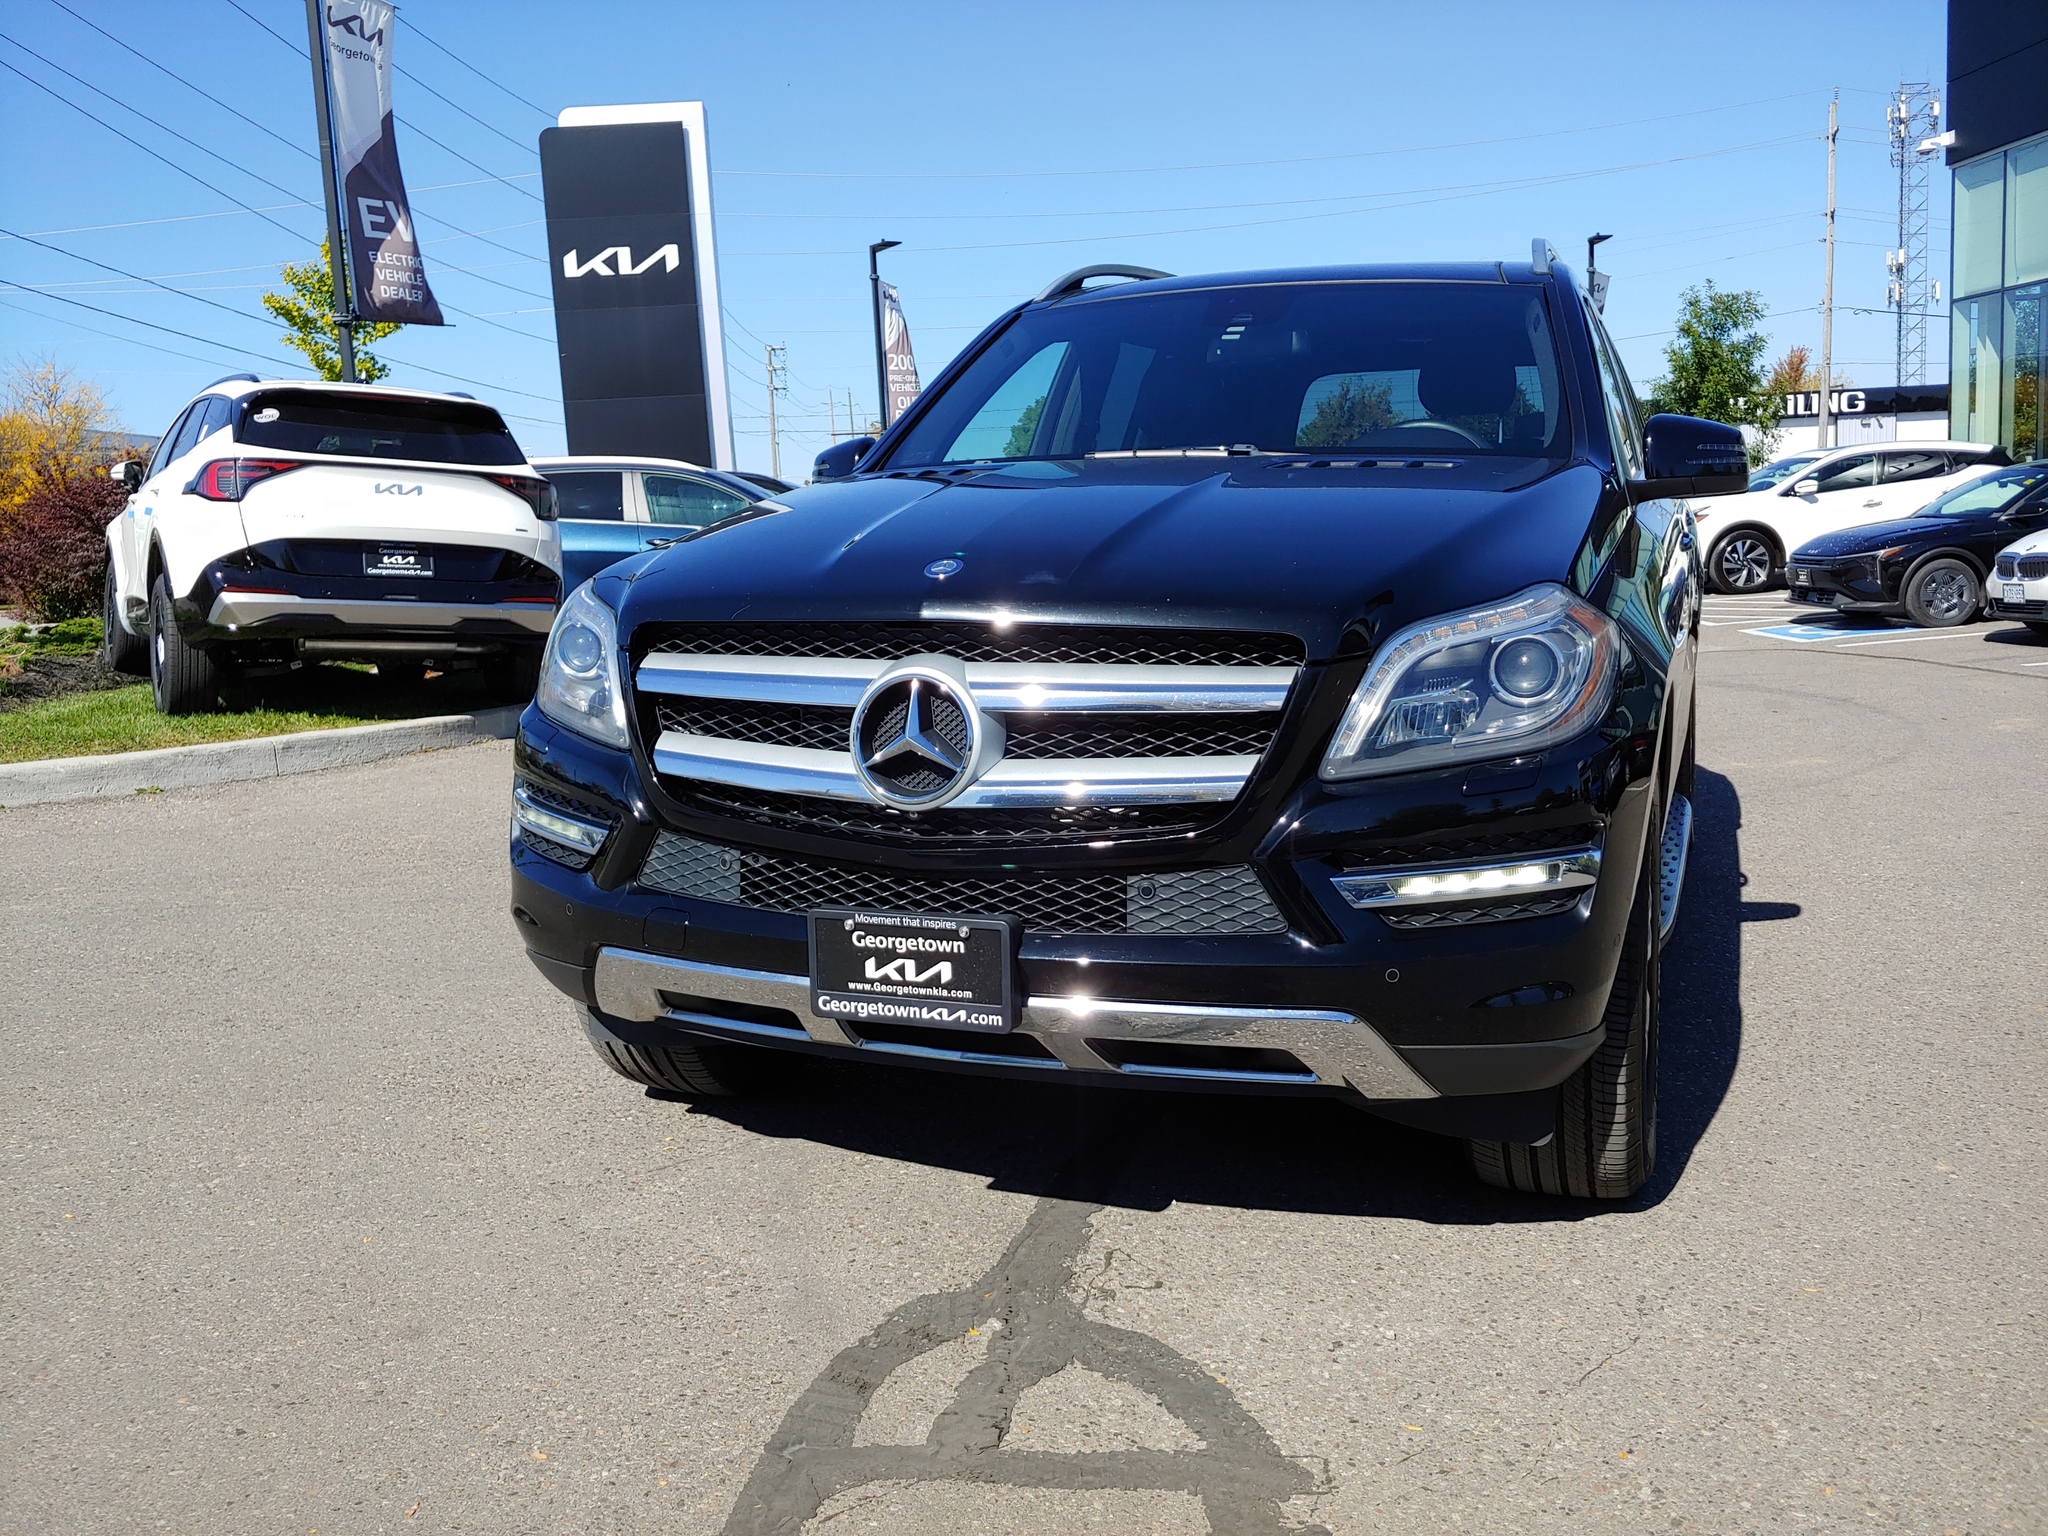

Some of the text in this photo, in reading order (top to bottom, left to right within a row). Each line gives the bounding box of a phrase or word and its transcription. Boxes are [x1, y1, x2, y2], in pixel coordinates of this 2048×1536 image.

[357, 196, 414, 243] EV
[368, 250, 423, 269] ELECTRIC
[563, 243, 680, 278] KIA
[375, 267, 424, 286] VEHICLE
[380, 285, 423, 303] DEALER
[374, 482, 423, 497] KIA
[378, 547, 419, 555] Georgetown
[382, 555, 415, 565] KIA
[854, 913, 957, 930] Movement that inspires
[851, 930, 965, 954] Georgetown
[864, 955, 953, 985] KIA
[847, 981, 973, 999] www.Georgetownkia.com
